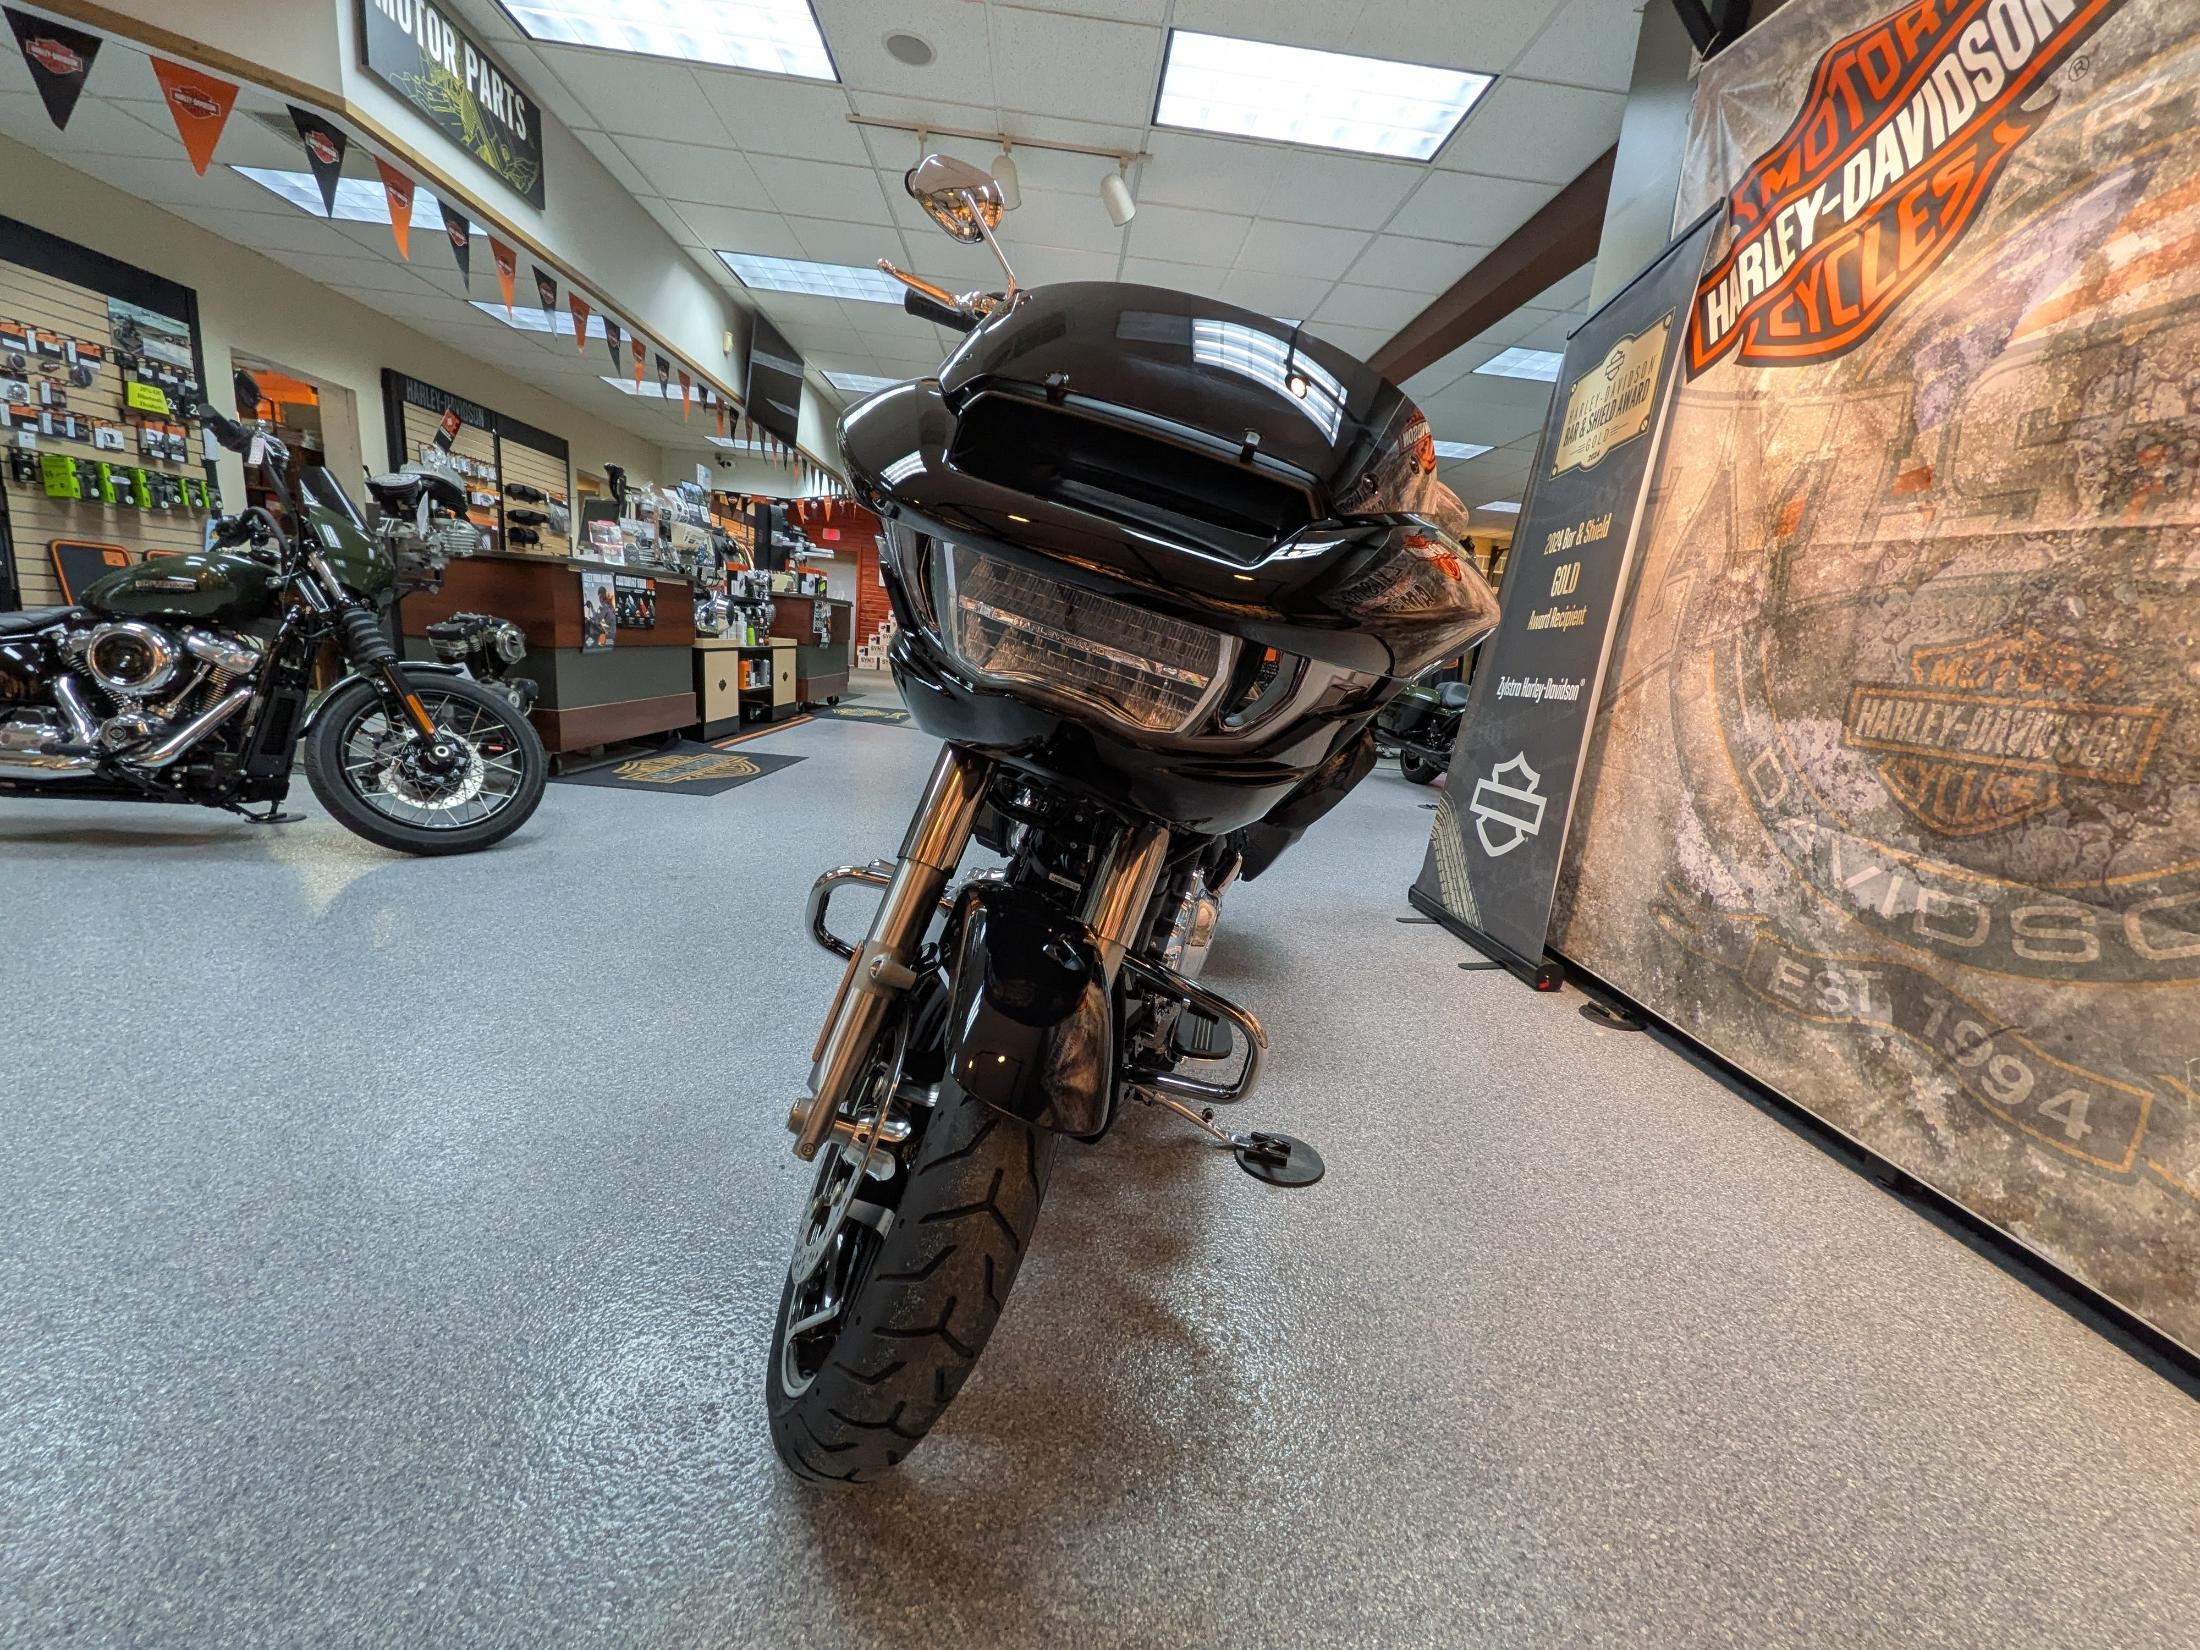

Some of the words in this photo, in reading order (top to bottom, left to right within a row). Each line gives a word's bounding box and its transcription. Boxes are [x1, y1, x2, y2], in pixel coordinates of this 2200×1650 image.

[464, 39, 528, 141] PARTS
[1768, 144, 1979, 338] CYCLES
[1563, 423, 1580, 447] BAR
[1579, 418, 1588, 439] &
[1587, 399, 1617, 434] SHIELD
[1616, 377, 1651, 415] AWARD
[1567, 354, 1656, 424] HARLEY-DAVIDSON
[1586, 428, 1610, 451] GOLD
[1544, 529, 1563, 556] 2024
[1562, 527, 1576, 549] Bar
[1575, 522, 1585, 546] &
[1584, 512, 1613, 543] Shield
[1550, 562, 1581, 597] GOLD
[1527, 608, 1551, 631] Award
[1550, 605, 1588, 632] Recipient
[1496, 676, 1522, 700] Zylstra
[1897, 758, 2043, 826] CYCLES
[1766, 955, 1884, 1014] EST
[1922, 996, 2094, 1141] 1994
